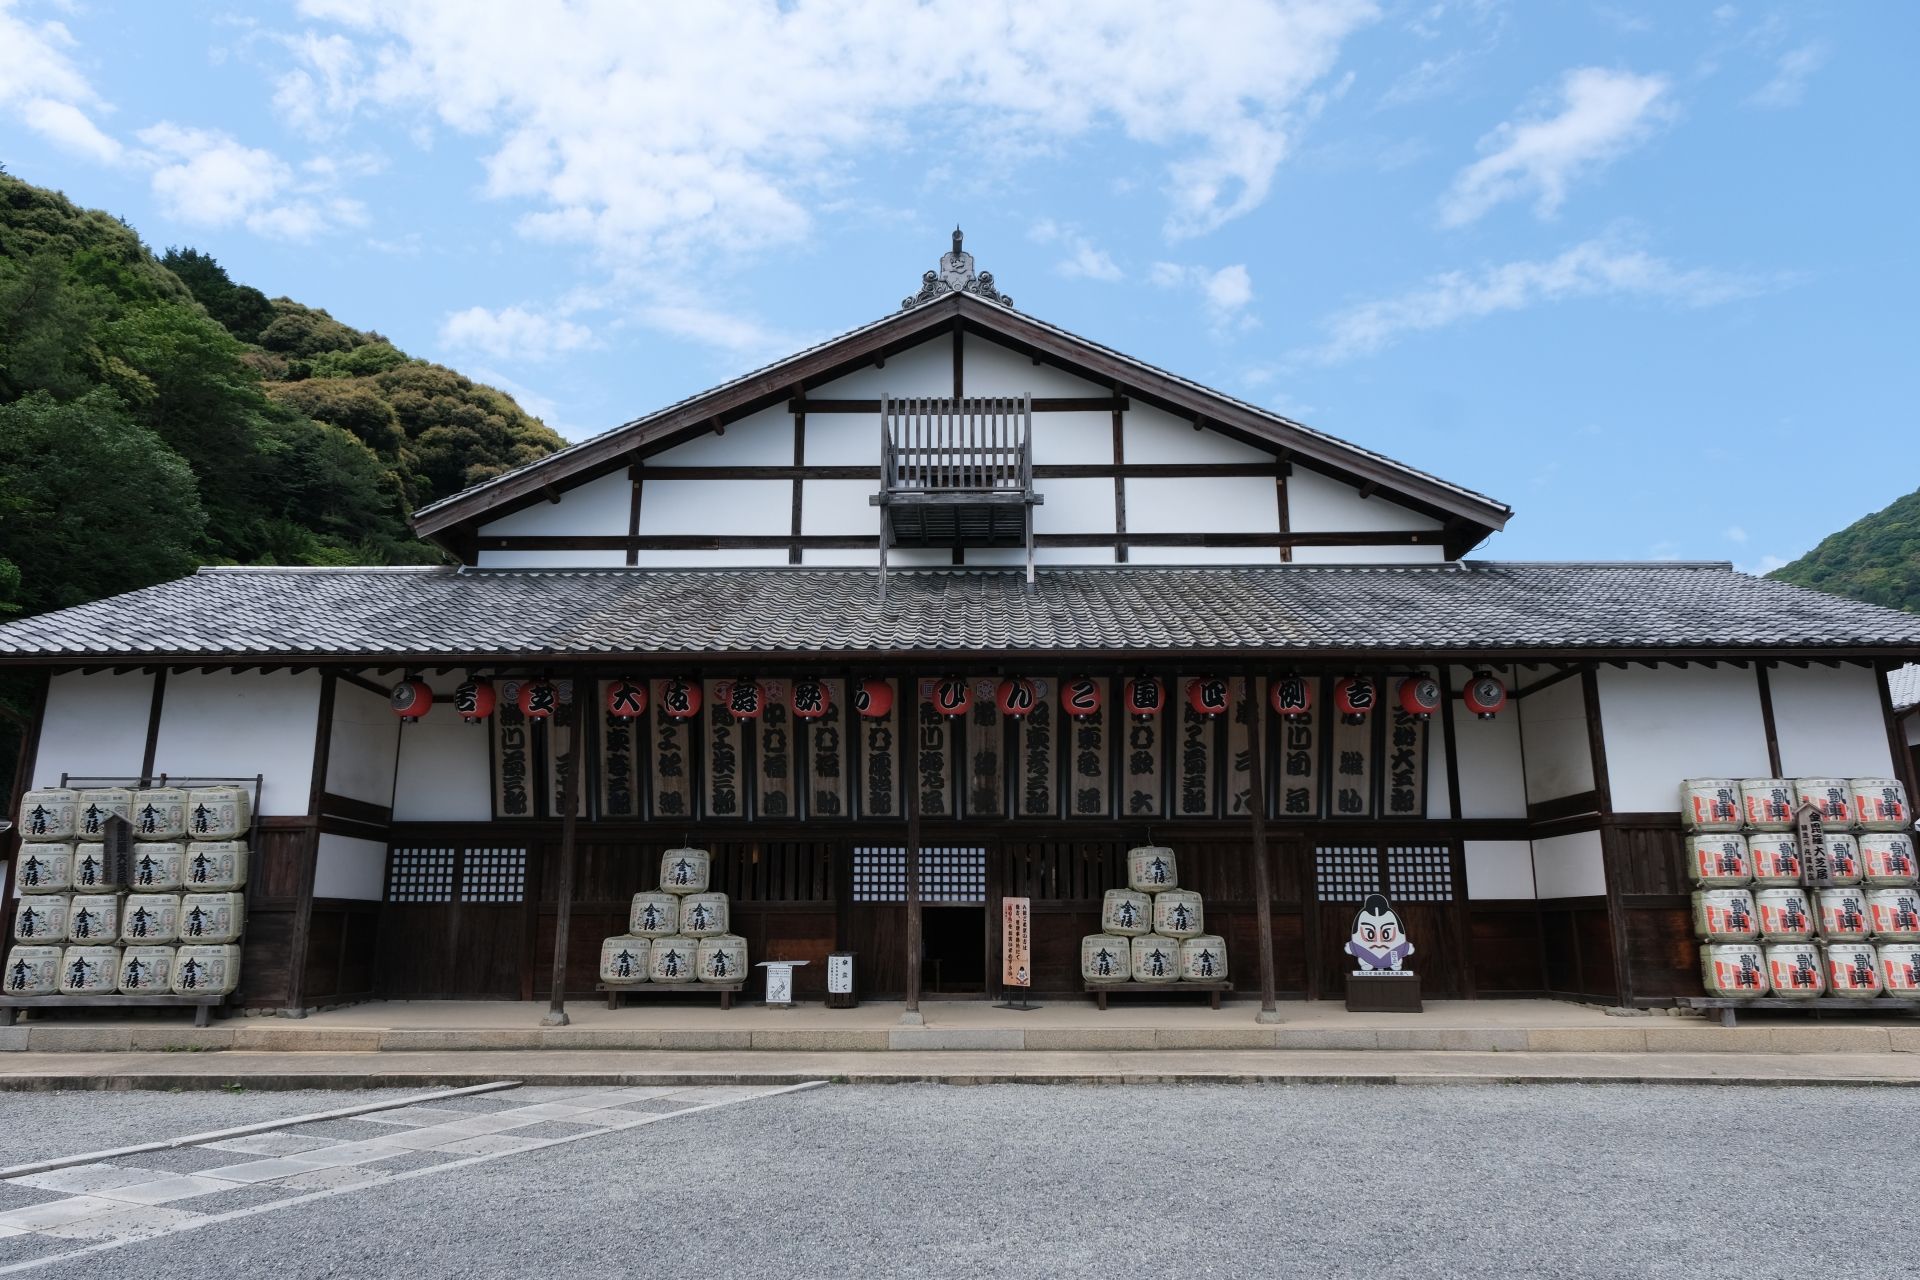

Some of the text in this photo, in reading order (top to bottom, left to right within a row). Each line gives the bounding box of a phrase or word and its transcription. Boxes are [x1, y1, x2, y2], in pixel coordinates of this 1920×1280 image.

[613, 682, 641, 712] 大
[1006, 679, 1033, 709] ん
[1071, 681, 1095, 708] こ
[1346, 680, 1372, 709] 吉
[32, 805, 51, 834] 金陵
[86, 803, 103, 833] 金陵
[142, 803, 160, 833] 金陵
[195, 804, 211, 833] 金陵
[25, 856, 43, 886] 金陵
[82, 855, 99, 885] 金陵
[140, 855, 157, 885] 金陵
[194, 853, 211, 883] 金陵
[675, 858, 691, 885] 金陵
[1152, 857, 1166, 884] 金陵
[21, 907, 39, 937] 金陵
[76, 907, 93, 938] 金陵
[133, 907, 152, 937] 金陵
[189, 906, 207, 936] 金陵
[644, 904, 660, 930] 金陵
[693, 904, 709, 930] 金陵
[1121, 901, 1136, 928] 金陵
[1174, 903, 1189, 930] 金陵
[12, 959, 31, 990] 金陵
[71, 957, 90, 988] 金陵
[127, 957, 144, 988] 金陵
[183, 958, 202, 988] 金陵
[618, 950, 634, 977] 金陵
[665, 949, 681, 976] 金陵
[713, 950, 729, 977] 金陵
[1097, 948, 1112, 975] 金陵
[1150, 949, 1166, 976] 金陵
[1199, 949, 1214, 976] 金陵
